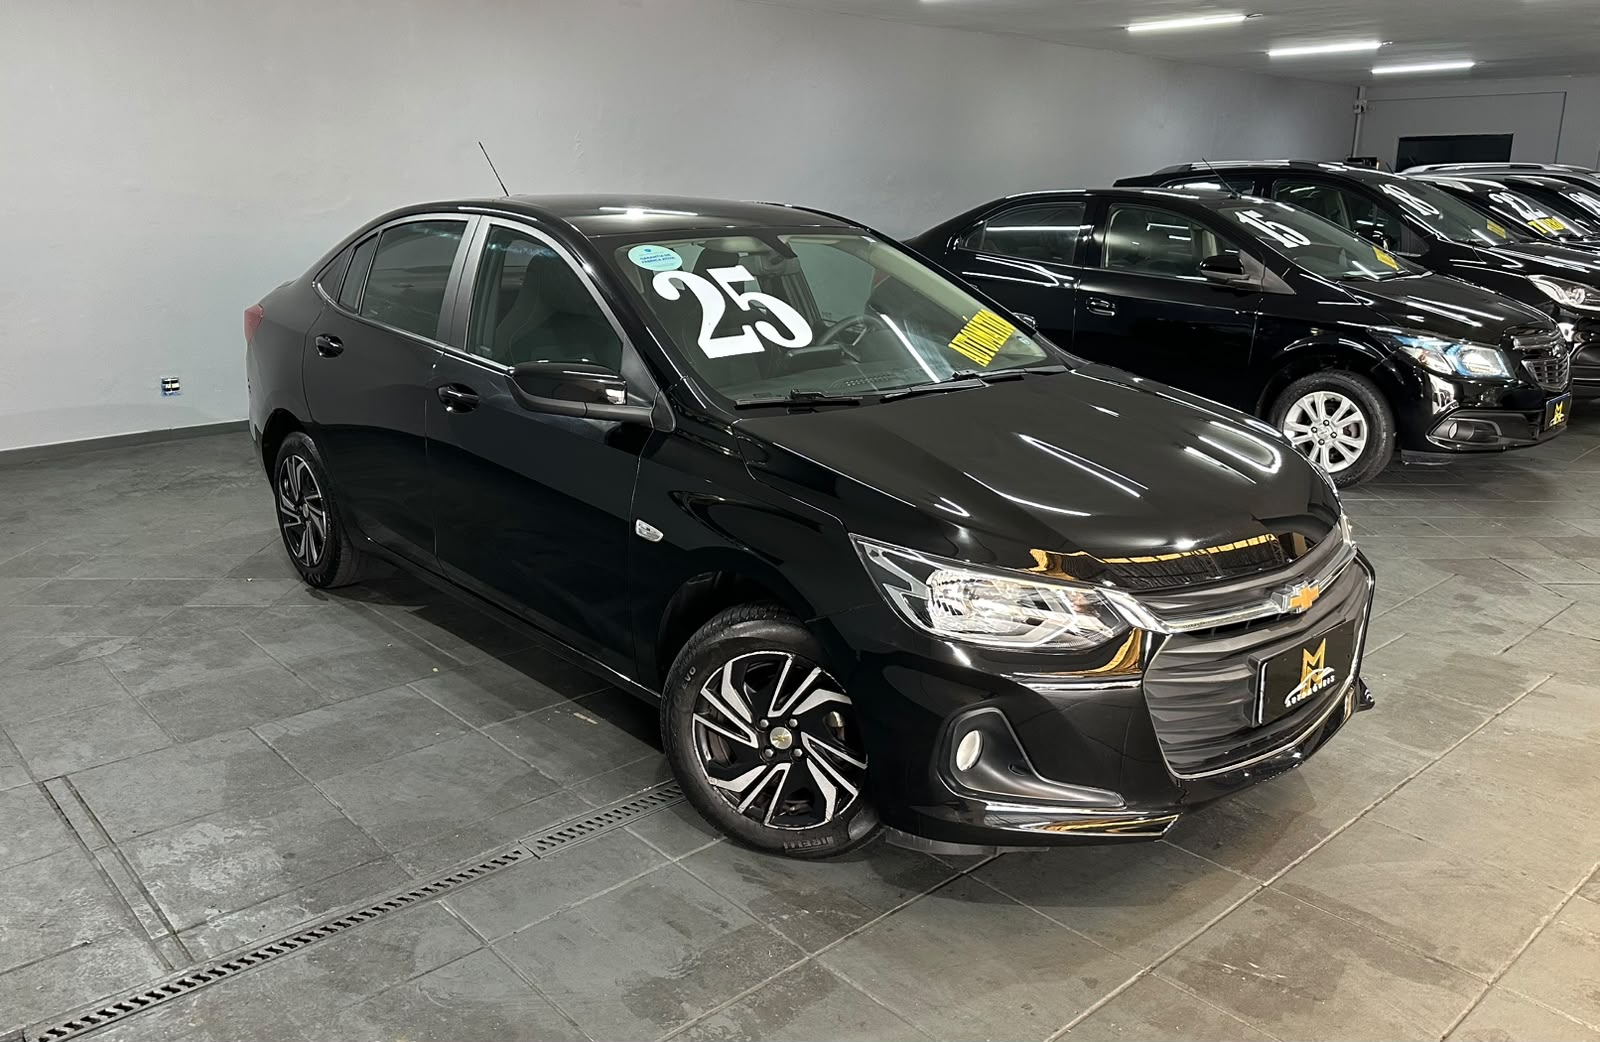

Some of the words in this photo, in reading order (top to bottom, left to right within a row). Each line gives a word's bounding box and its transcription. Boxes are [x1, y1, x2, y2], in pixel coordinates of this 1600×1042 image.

[1379, 184, 1440, 216] 18
[1234, 210, 1311, 248] 15
[652, 265, 813, 359] 25
